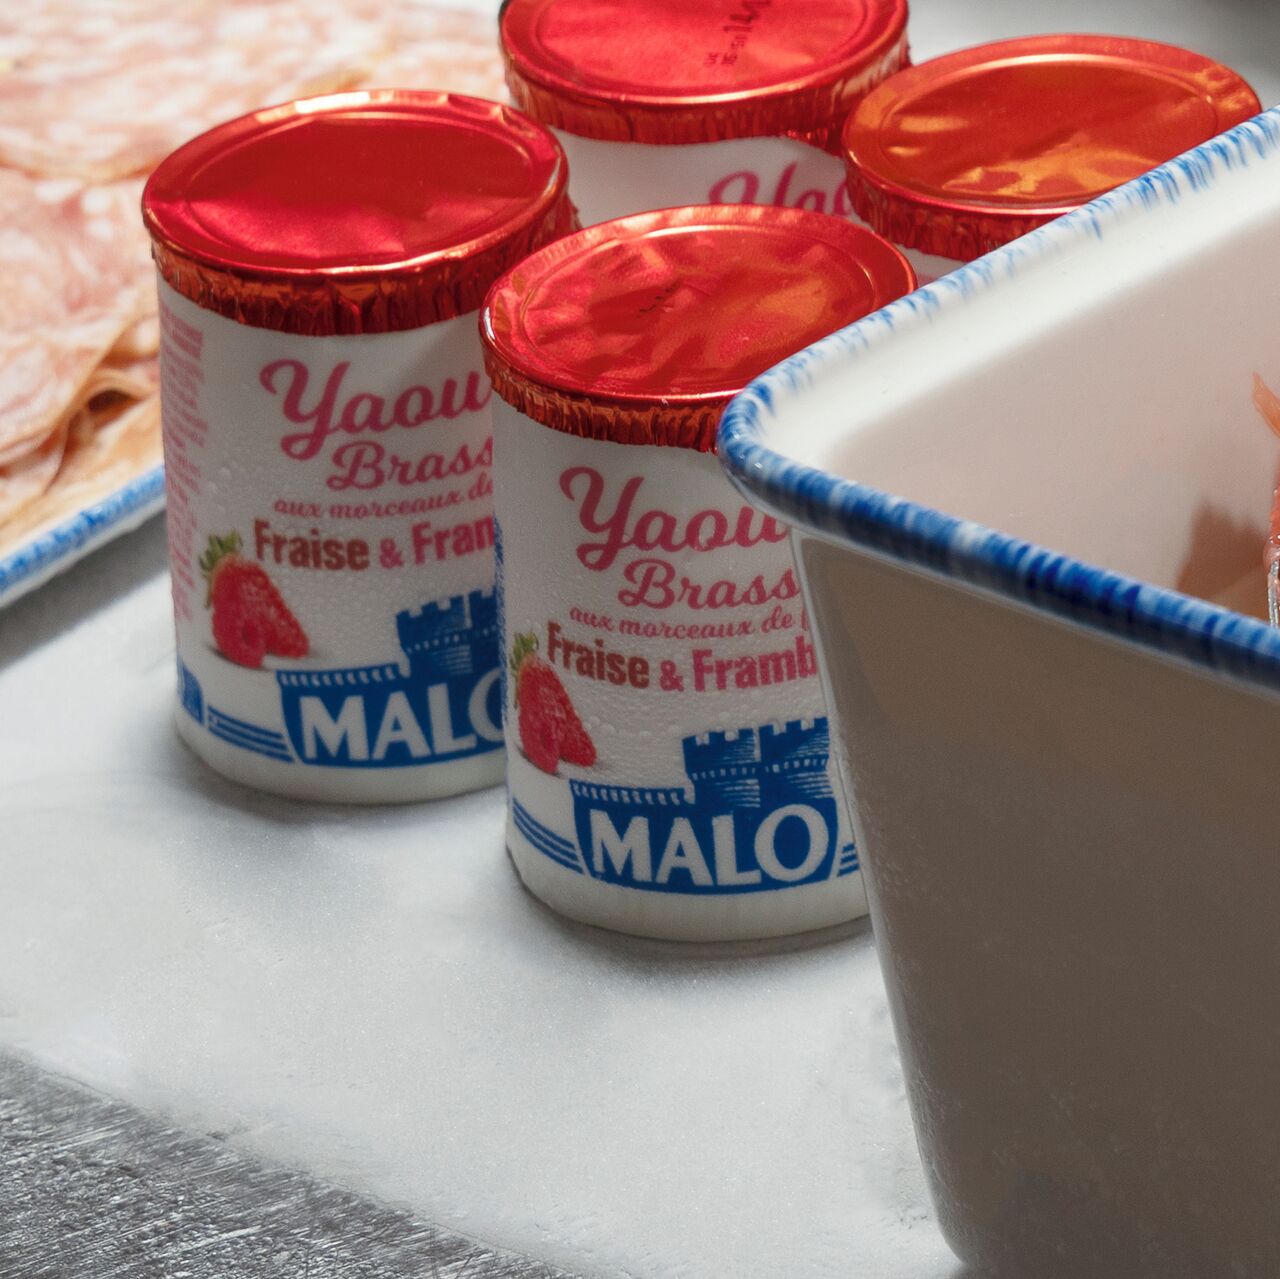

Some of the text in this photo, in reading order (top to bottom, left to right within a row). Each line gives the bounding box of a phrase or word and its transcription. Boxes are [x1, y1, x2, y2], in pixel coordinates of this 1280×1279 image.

[274, 497, 324, 518] aux
[329, 491, 464, 519] morceaux
[253, 517, 370, 571] Fraise
[378, 537, 405, 570] &
[617, 557, 801, 611] Brass
[569, 604, 613, 631] aux
[619, 614, 755, 639] morceaux
[760, 603, 796, 634] de
[546, 620, 650, 689] Fraise
[659, 661, 684, 692] &
[589, 803, 830, 887] MALO
